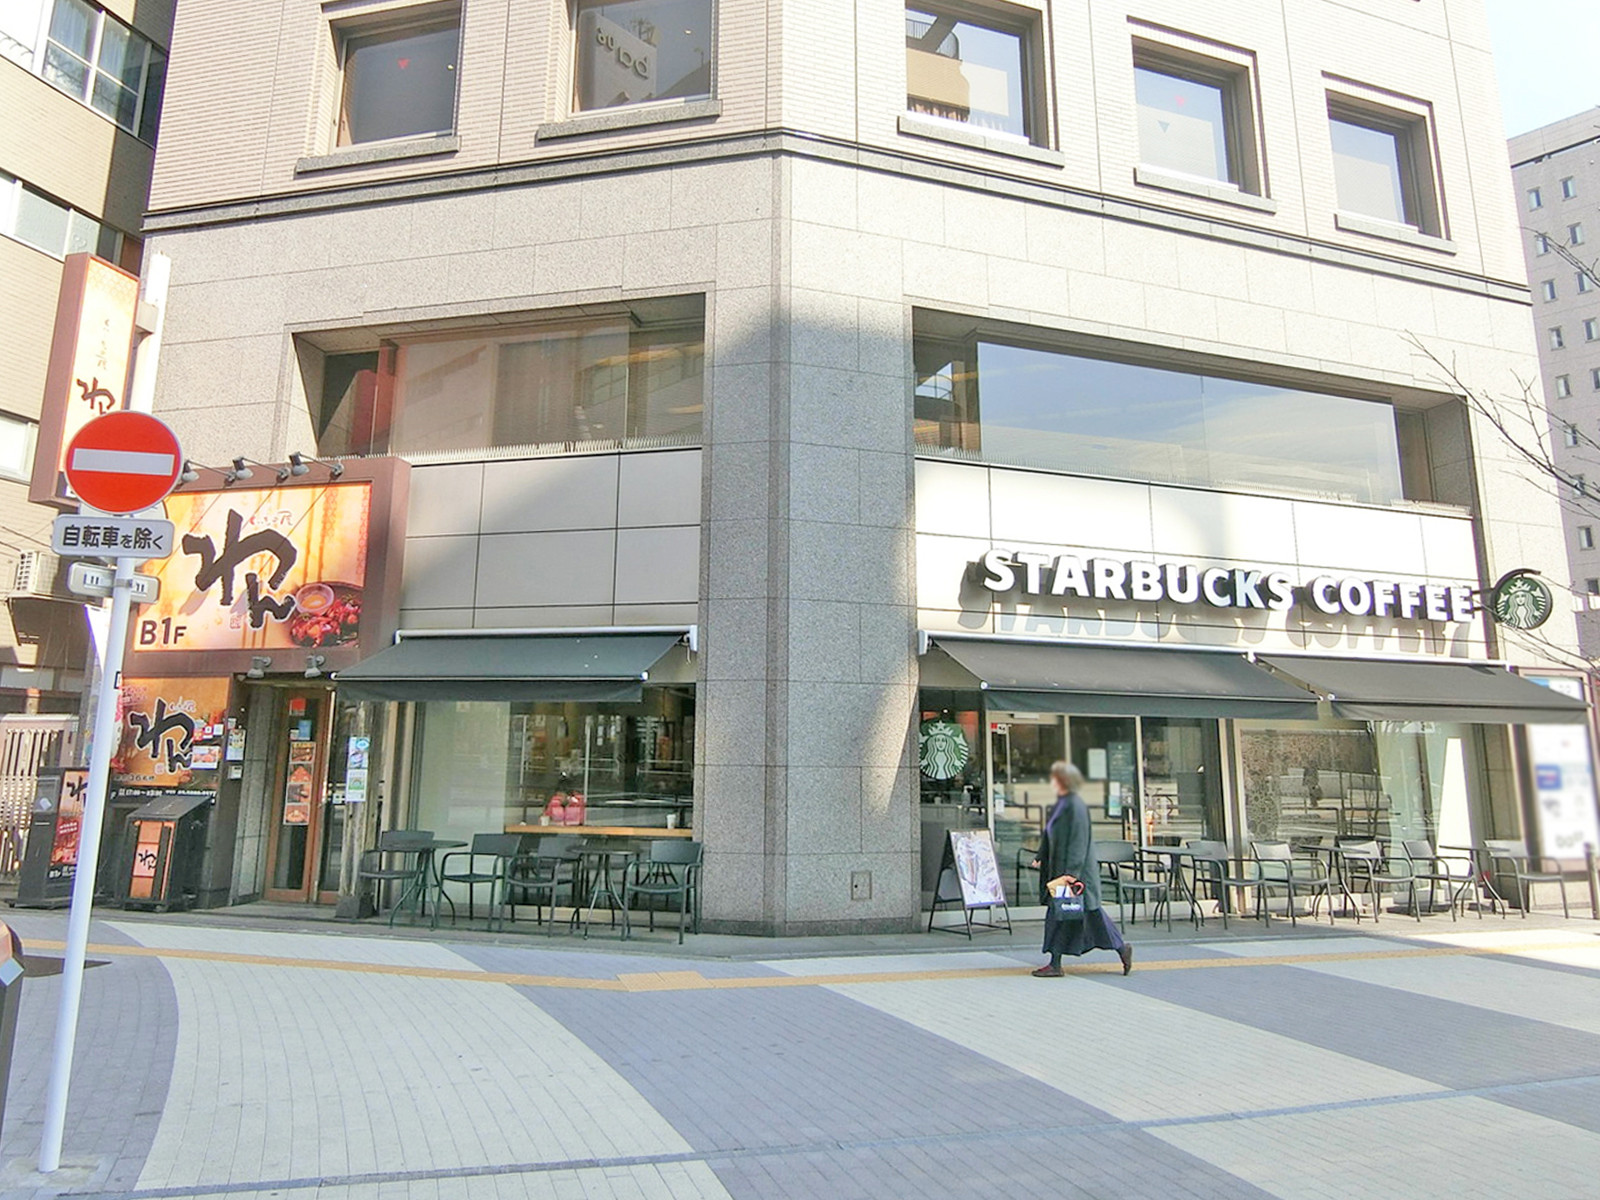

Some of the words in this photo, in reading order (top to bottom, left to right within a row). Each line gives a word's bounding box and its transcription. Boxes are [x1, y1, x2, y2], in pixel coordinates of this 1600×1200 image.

[62, 524, 164, 550] 自転車を除く
[181, 508, 298, 629] わん
[983, 548, 1294, 611] STARBUCKS
[1311, 574, 1474, 623] COFFEE
[139, 617, 187, 645] B1F
